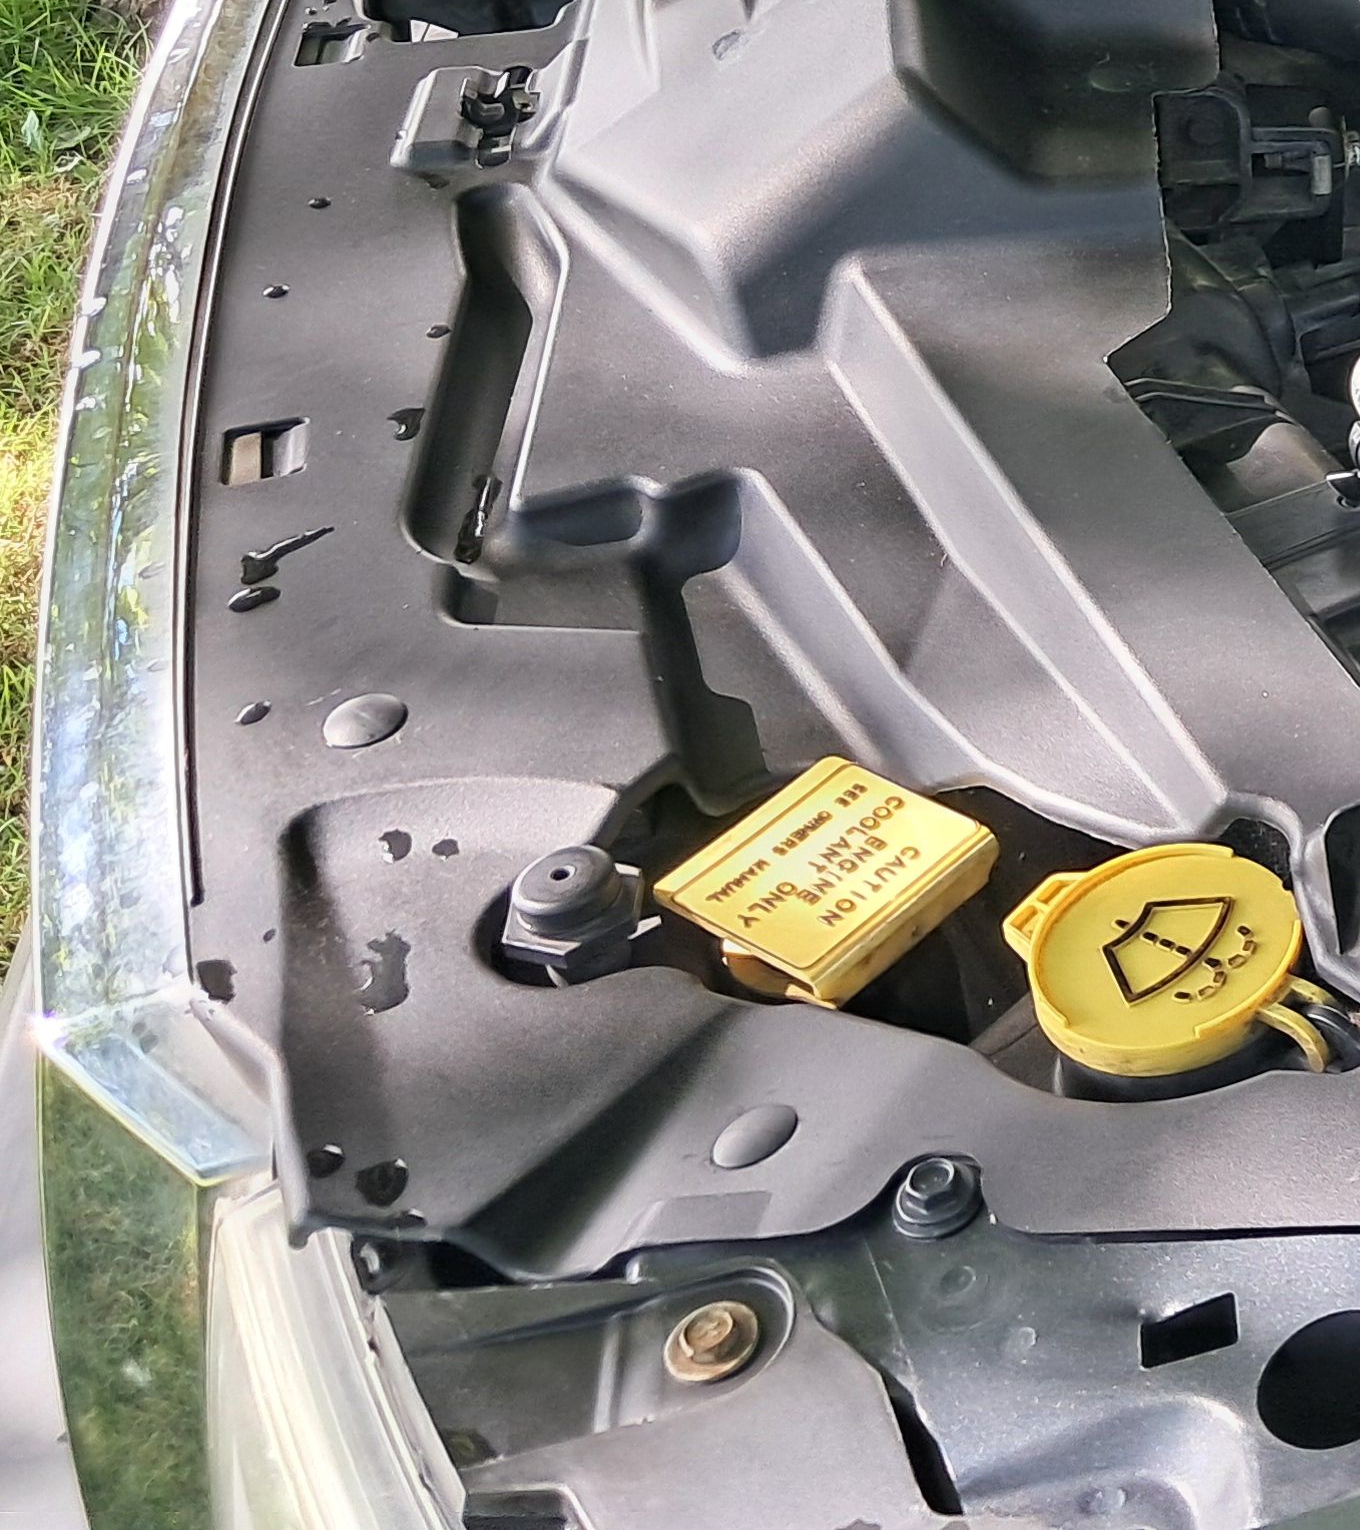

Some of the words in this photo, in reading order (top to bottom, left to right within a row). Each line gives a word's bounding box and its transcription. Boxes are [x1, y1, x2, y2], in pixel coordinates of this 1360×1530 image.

[834, 783, 869, 808] SEE
[808, 795, 905, 874] COOLANT
[705, 859, 771, 902] MANUAL
[795, 835, 888, 906] ENGINE
[817, 846, 921, 927] CAUTION
[737, 881, 799, 928] ONLY
